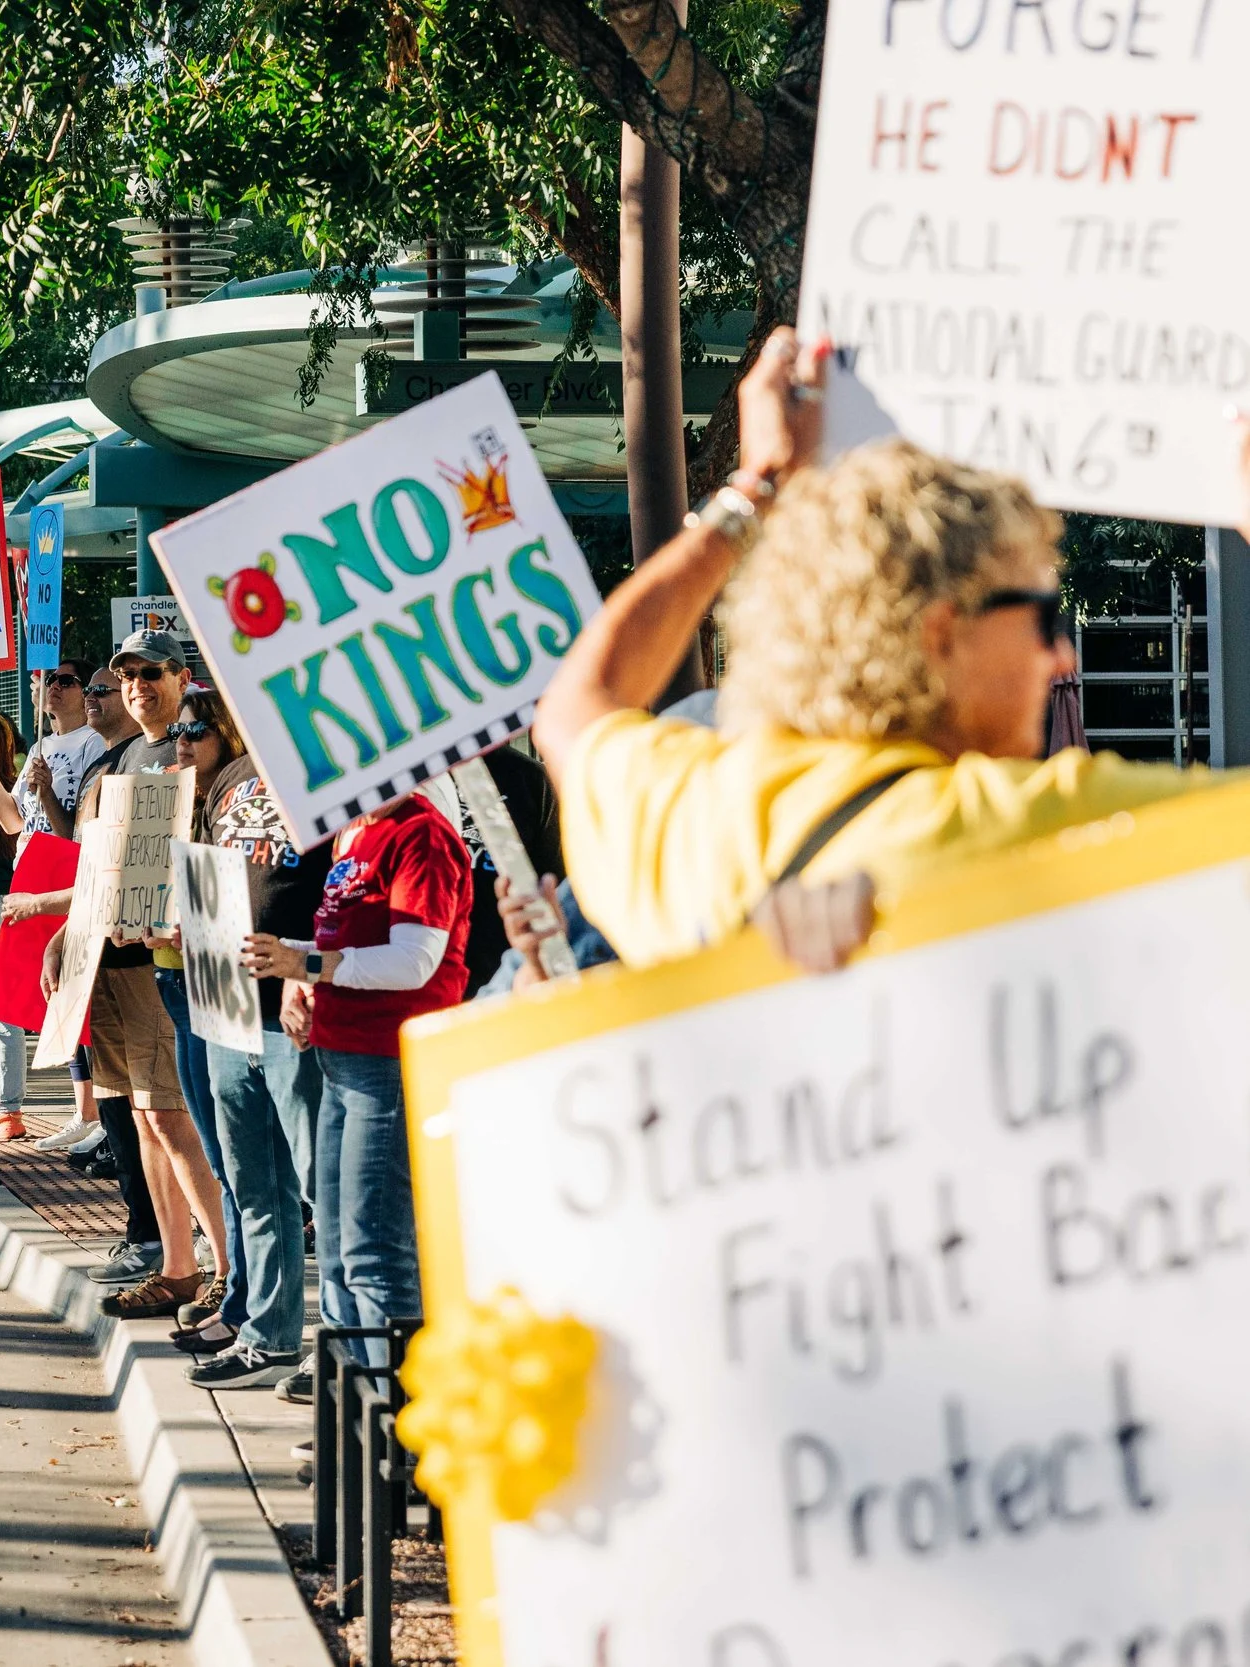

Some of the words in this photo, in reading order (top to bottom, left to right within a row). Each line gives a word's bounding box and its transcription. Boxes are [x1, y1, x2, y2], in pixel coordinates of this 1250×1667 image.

[870, 94, 951, 173] HE
[850, 202, 1020, 277] CALL
[1058, 214, 1181, 279] THE
[1075, 308, 1250, 393] GUARD
[282, 478, 450, 626] NO
[37, 583, 51, 604] NO
[130, 601, 178, 611] Chandler
[130, 612, 178, 633] Flex
[29, 623, 59, 646] KINGS
[260, 535, 583, 794] KINGS
[109, 788, 127, 824] NO
[130, 782, 192, 822] DETENTIONS
[104, 831, 123, 867] NO
[186, 852, 219, 920] NO
[96, 885, 154, 928] ABOLISH
[153, 883, 177, 929] IC
[186, 939, 256, 1029] KINGS
[555, 998, 902, 1216] Stand
[986, 978, 1133, 1160] Up
[719, 1182, 974, 1384] Fight
[780, 1358, 1166, 1580] Protect
